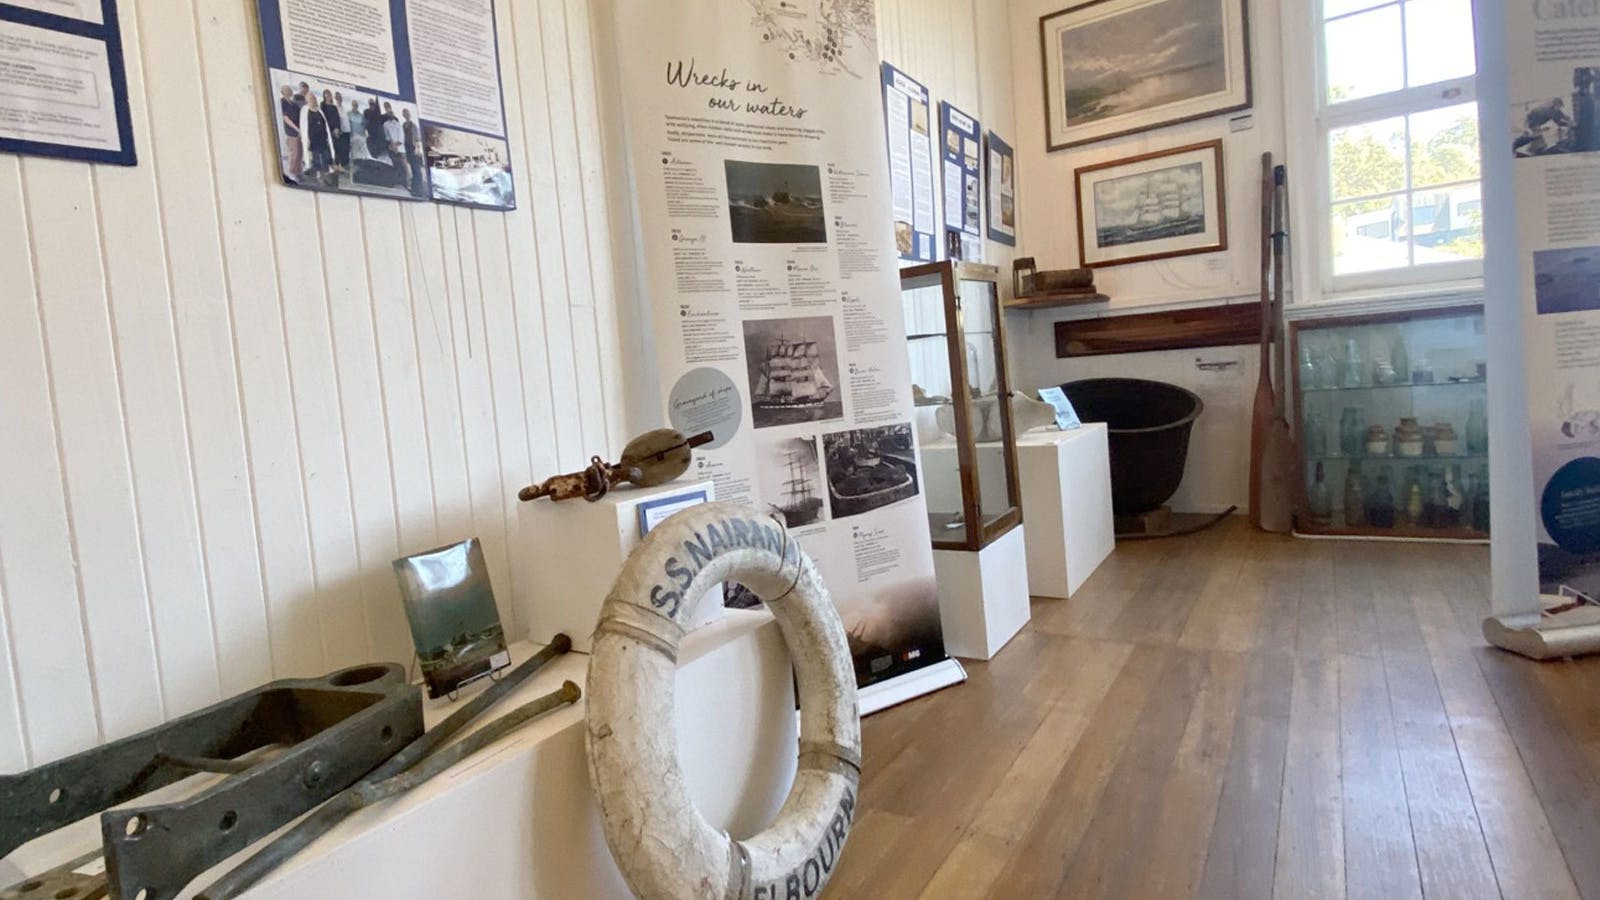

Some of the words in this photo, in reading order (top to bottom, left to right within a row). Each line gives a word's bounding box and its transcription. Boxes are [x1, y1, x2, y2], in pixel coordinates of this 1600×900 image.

[666, 57, 741, 91] Wrecks
[746, 79, 768, 93] in
[708, 97, 740, 112] our
[746, 97, 808, 119] waters
